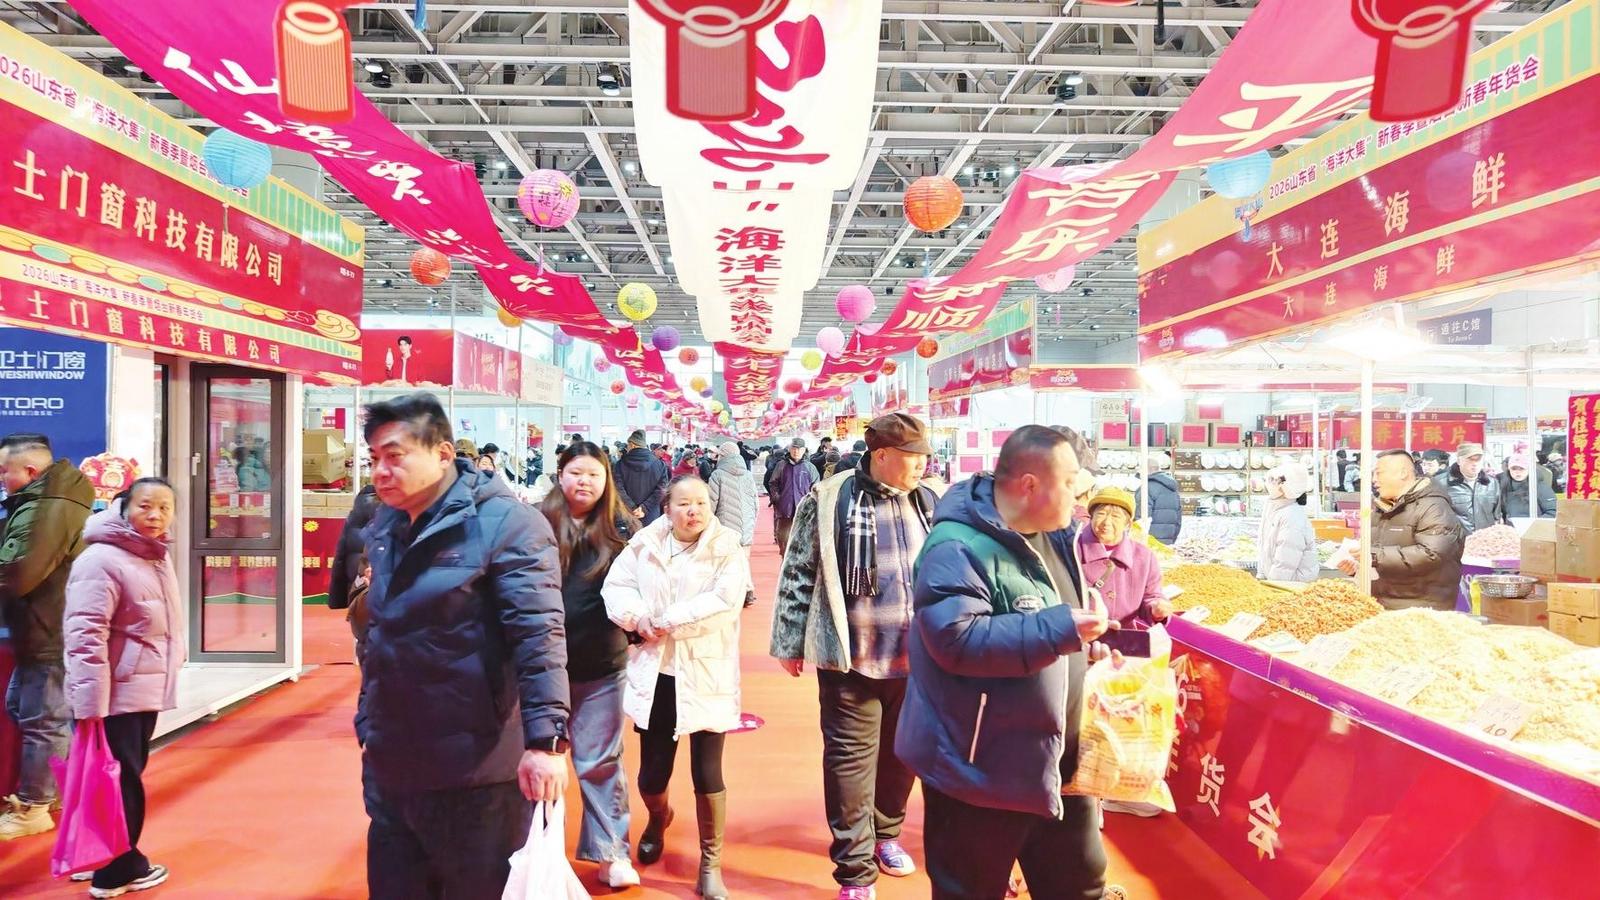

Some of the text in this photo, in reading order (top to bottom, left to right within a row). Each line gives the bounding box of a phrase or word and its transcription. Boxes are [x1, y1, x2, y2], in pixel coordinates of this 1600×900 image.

[14, 149, 283, 287] 士门窗科技有限公司
[1268, 165, 1318, 200] 2026山东省
[0, 289, 281, 365] 士门窗科技有限公司
